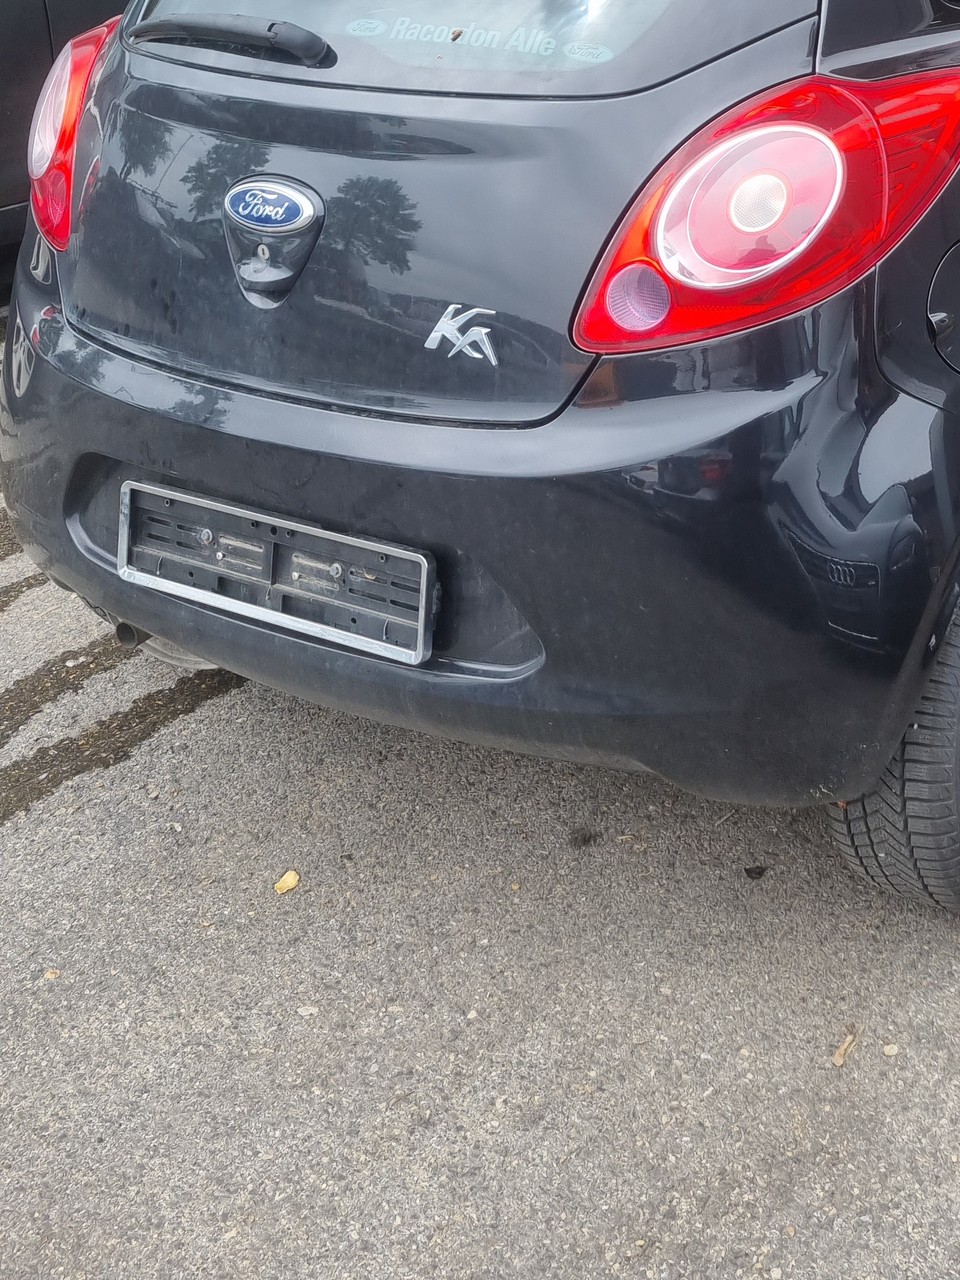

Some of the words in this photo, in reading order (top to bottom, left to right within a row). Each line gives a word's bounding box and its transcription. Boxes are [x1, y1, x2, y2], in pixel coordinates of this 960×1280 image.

[389, 17, 502, 49] Racodon
[503, 30, 557, 56] Alle
[238, 190, 288, 222] Ford
